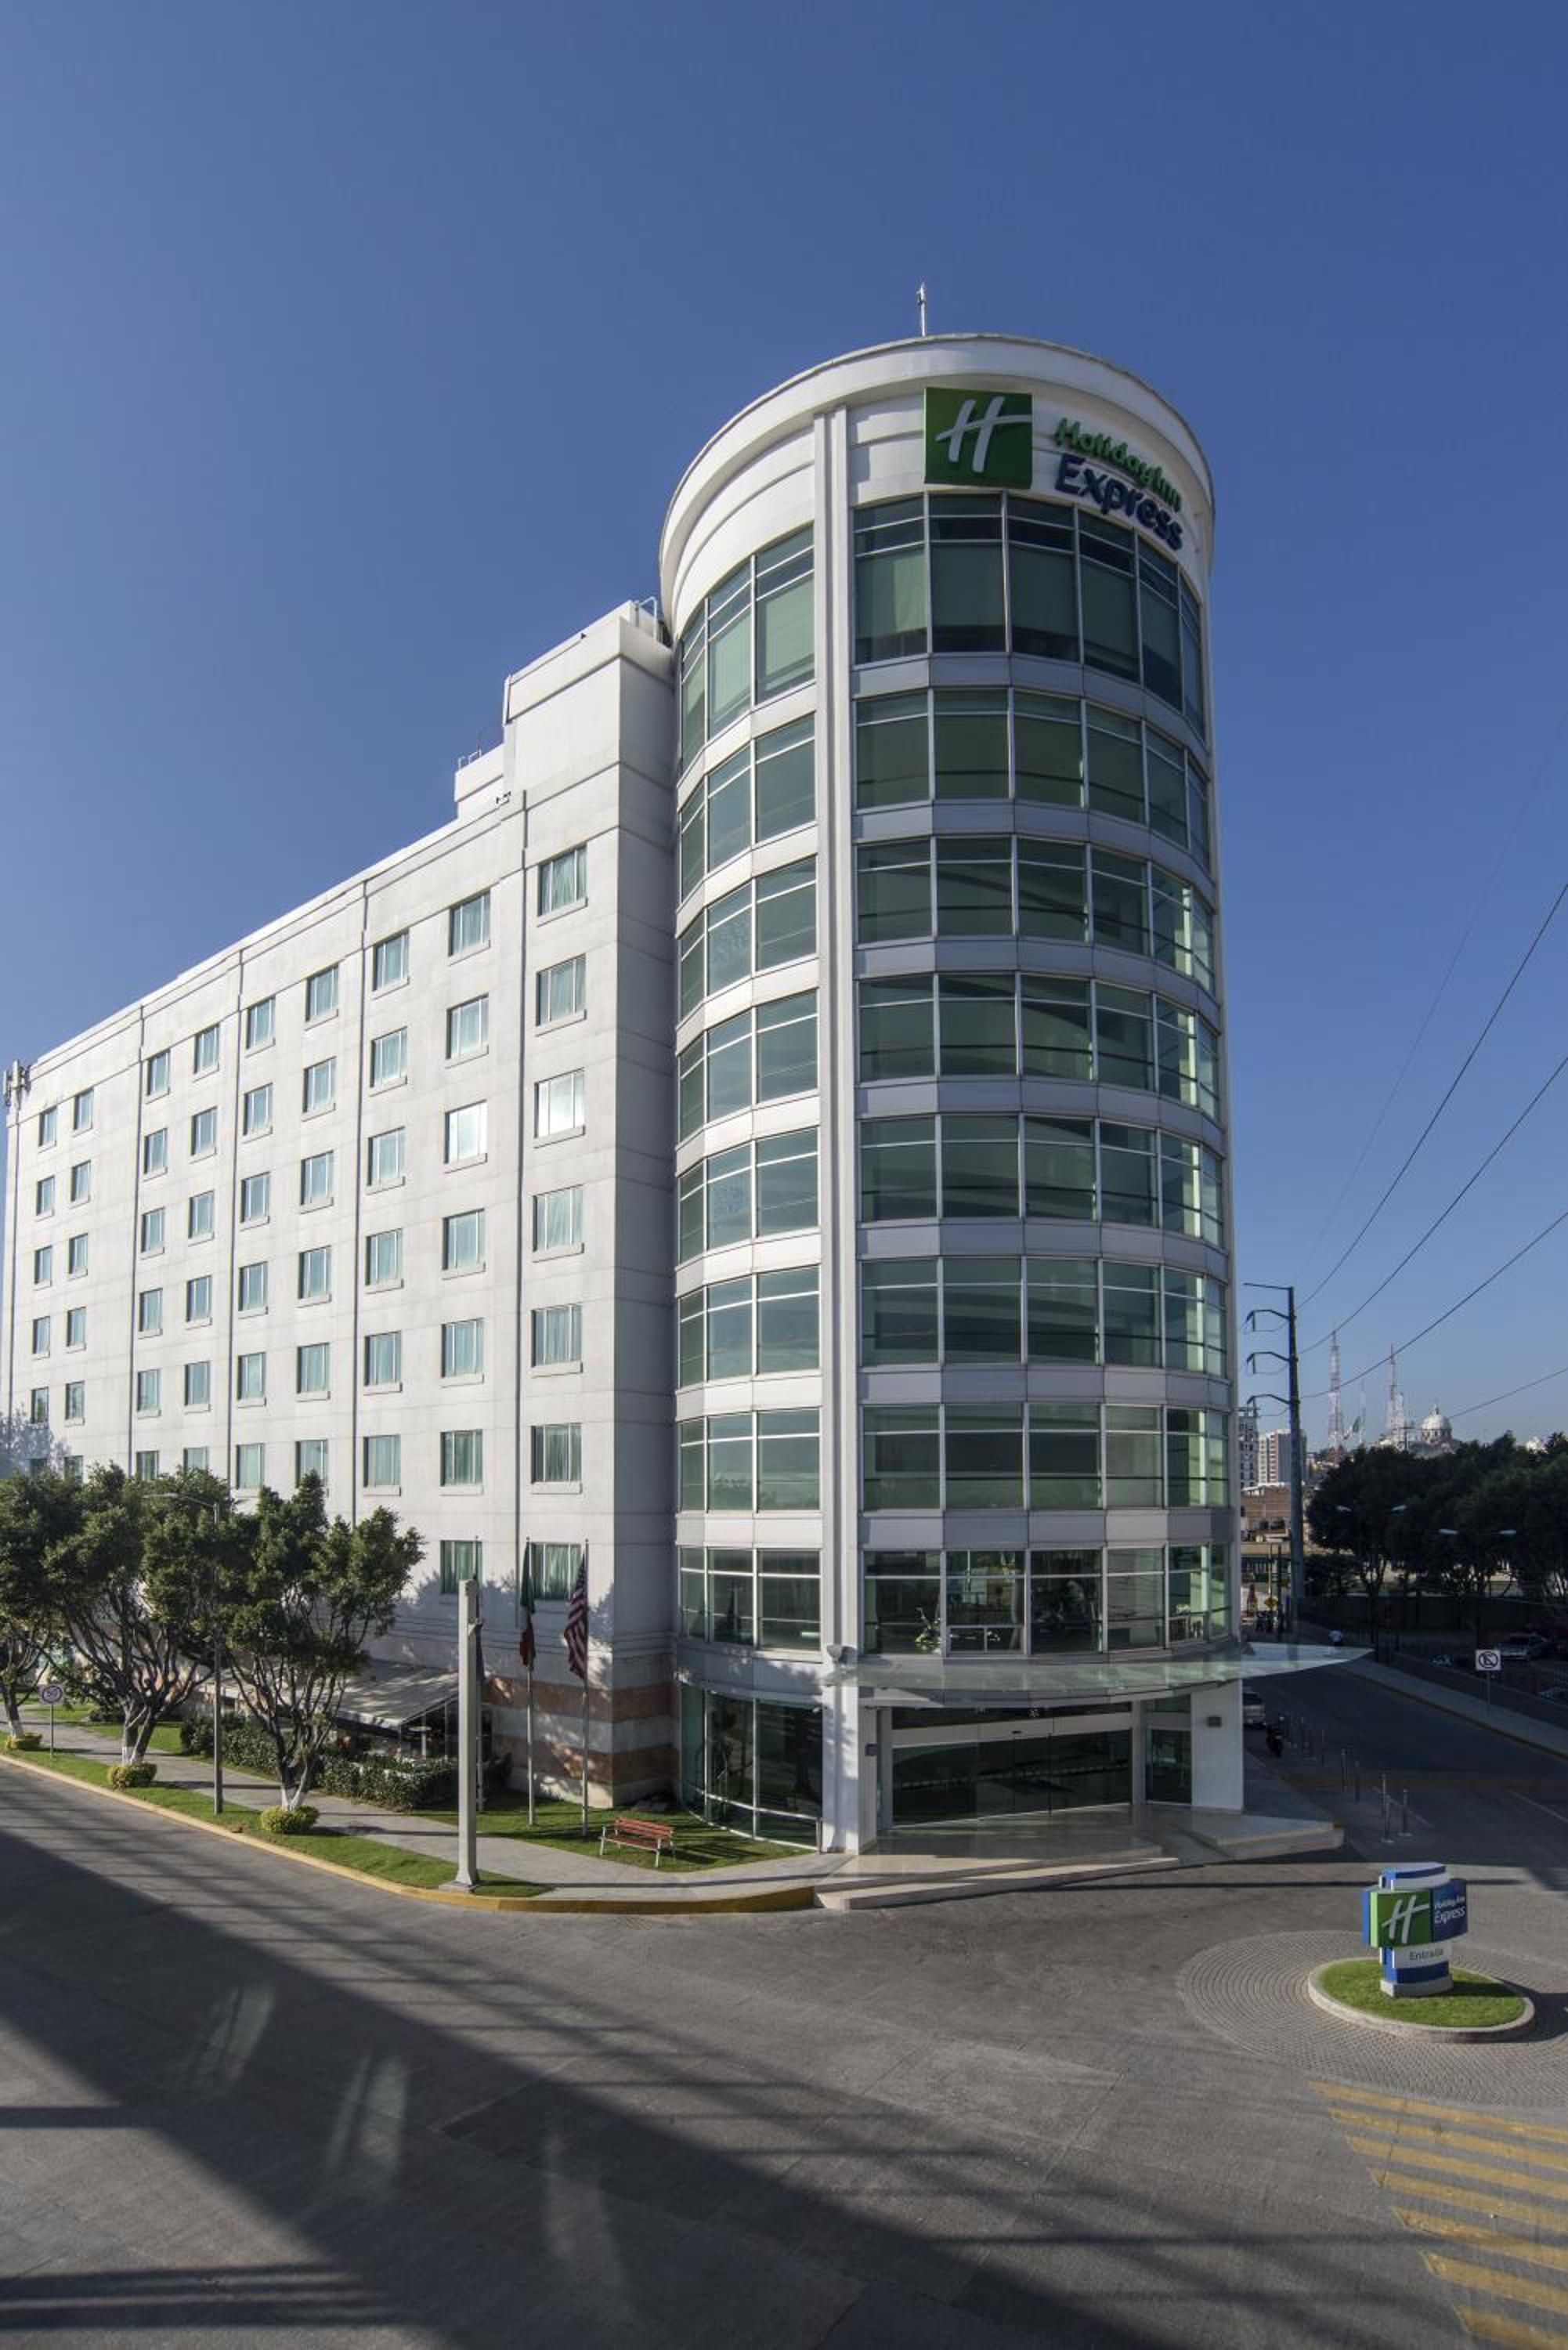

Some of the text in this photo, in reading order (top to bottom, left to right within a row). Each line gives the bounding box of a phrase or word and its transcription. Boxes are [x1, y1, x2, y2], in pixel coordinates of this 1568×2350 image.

[1055, 418, 1181, 512] Holiday Inn
[1055, 454, 1183, 551] Express
